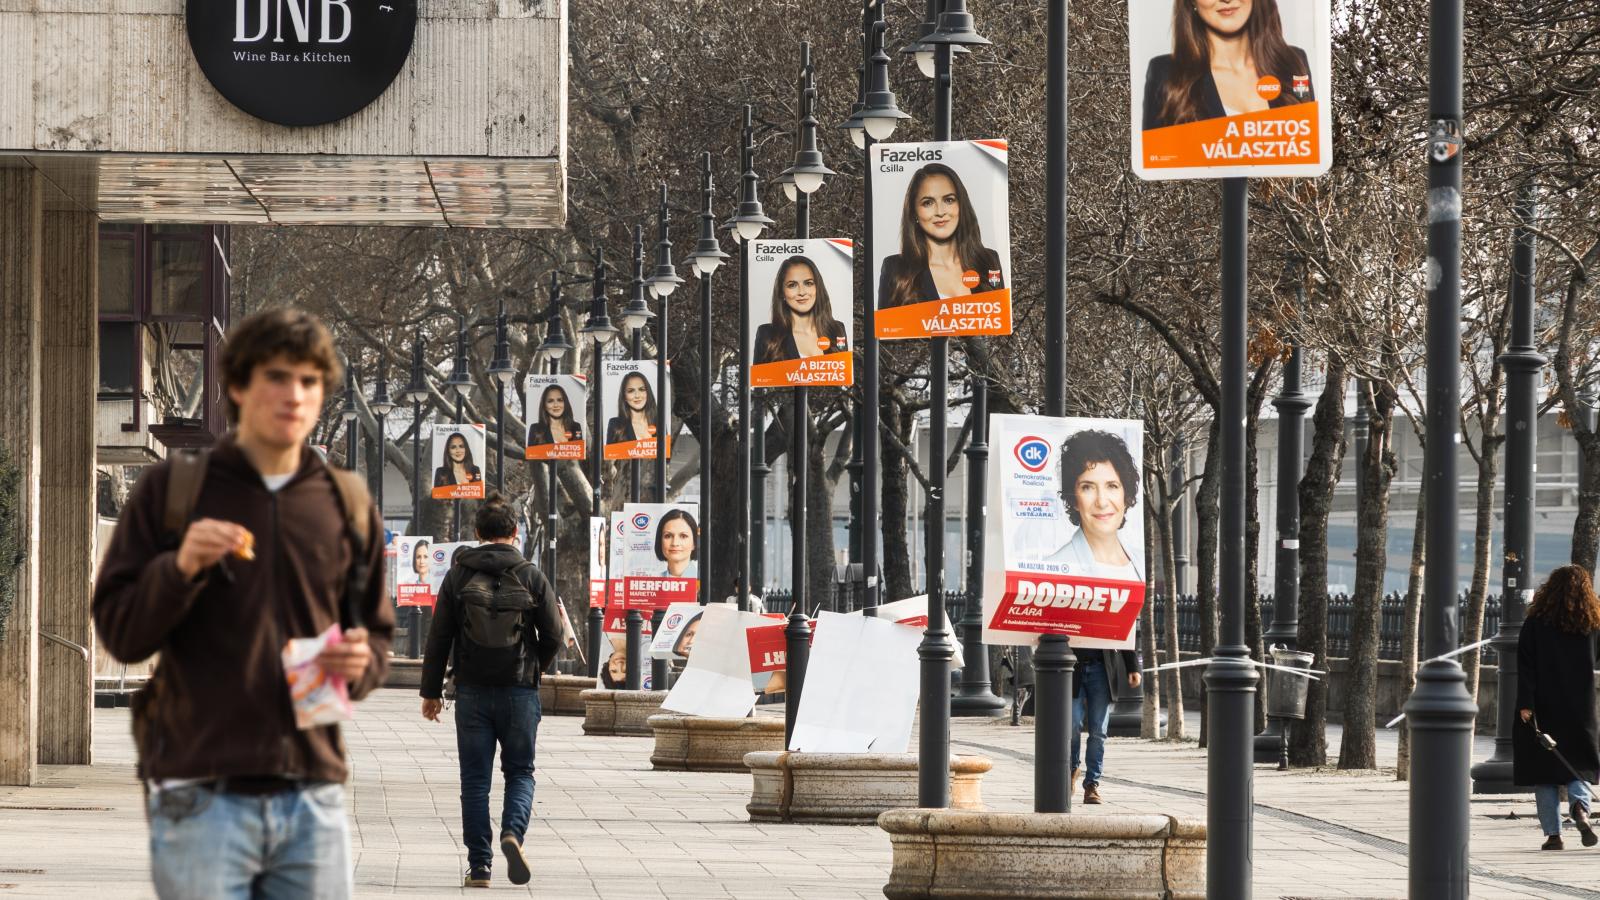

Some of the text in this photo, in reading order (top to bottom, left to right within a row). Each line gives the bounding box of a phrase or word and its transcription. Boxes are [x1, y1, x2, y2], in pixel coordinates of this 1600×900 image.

[233, 51, 266, 62] Wine
[270, 51, 290, 62] Bar
[303, 52, 351, 63] Kitchen
[1225, 119, 1311, 137] A BIZTOS
[1202, 138, 1311, 159] VÁLASZTÁS
[880, 147, 943, 163] Fazekas
[880, 164, 904, 173] Csilla
[755, 242, 805, 254] Fazekas
[939, 302, 1002, 315] A BIZTOS
[921, 315, 1002, 331] VÁLASZTÁS
[606, 363, 639, 371] Fazekas
[799, 360, 846, 370] A BIZTOS
[786, 370, 846, 382] VÁLASZTÁS
[1025, 446, 1043, 460] dk
[630, 580, 688, 592] HERFORT
[1013, 580, 1131, 614] DOBREV
[1007, 606, 1043, 616] KLÁRA
